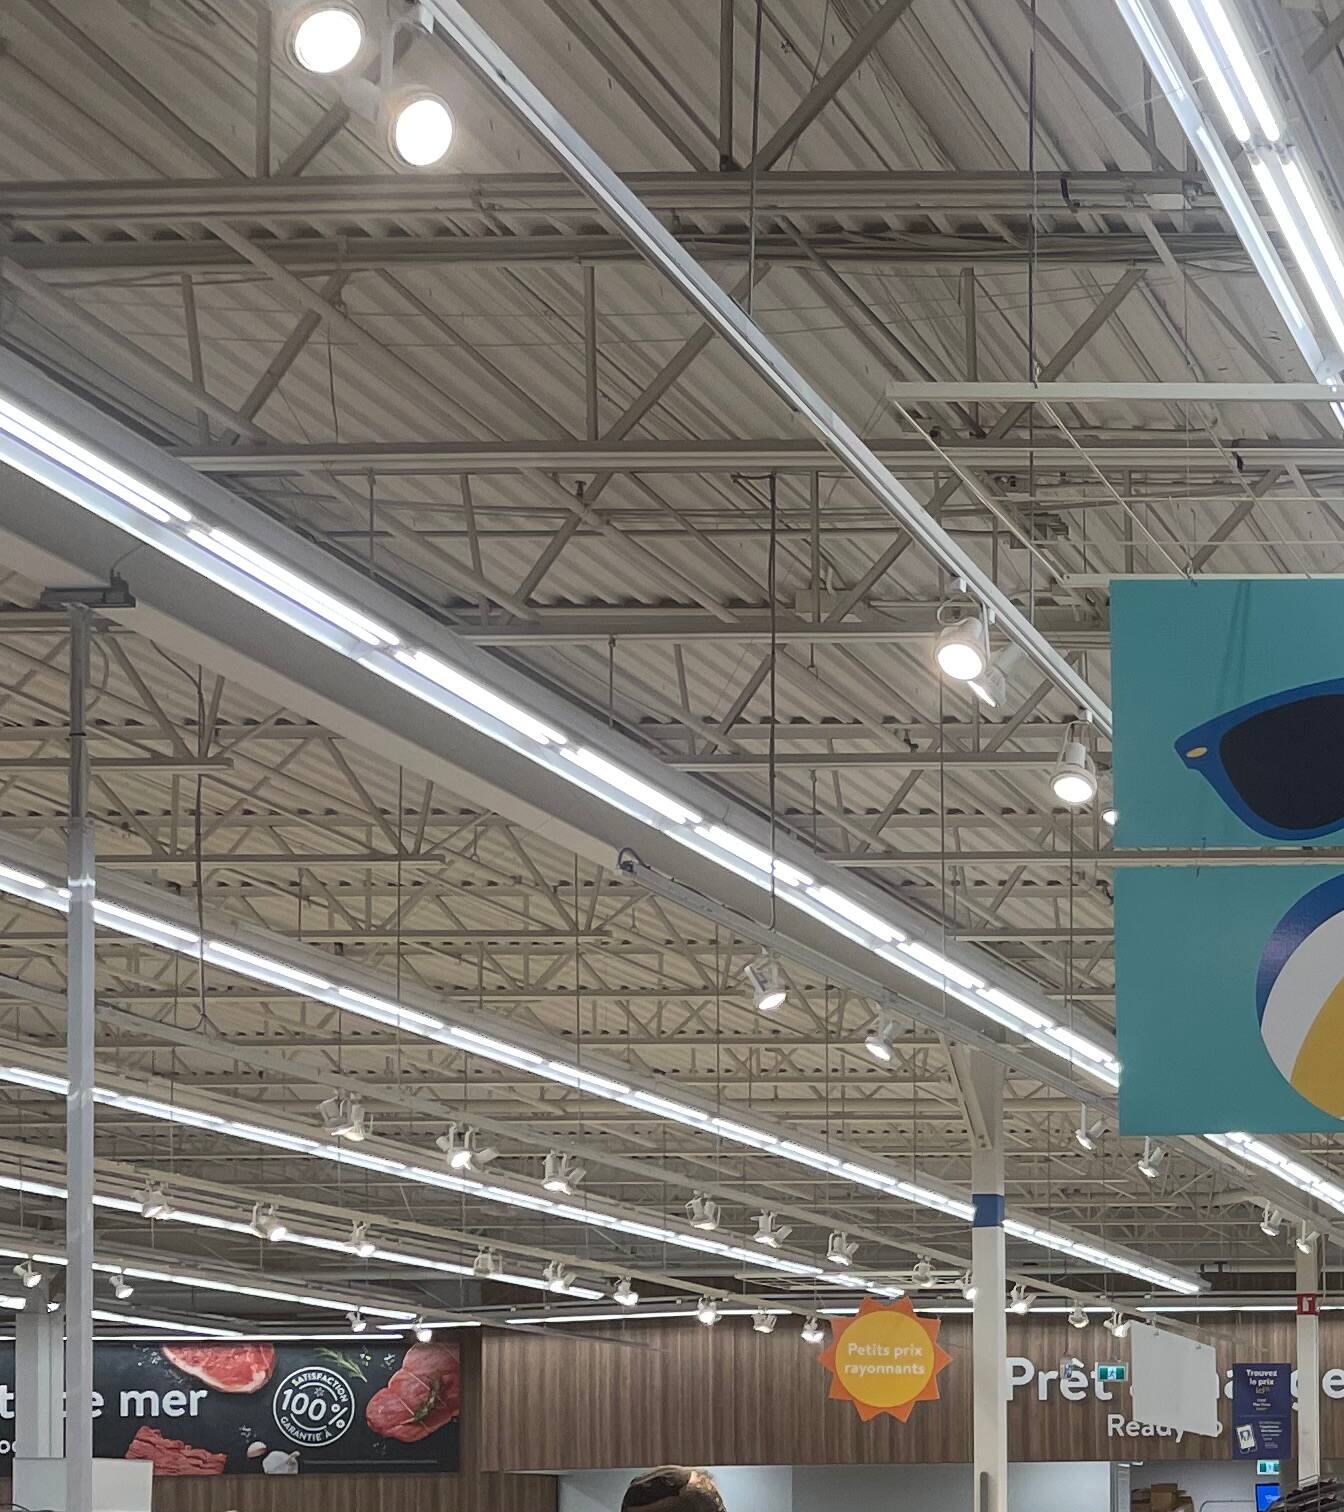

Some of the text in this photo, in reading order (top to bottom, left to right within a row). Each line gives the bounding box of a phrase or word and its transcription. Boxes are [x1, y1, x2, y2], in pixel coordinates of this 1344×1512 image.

[847, 1343, 922, 1360] Petits prix
[844, 1363, 925, 1377] rayonnants
[1006, 1357, 1112, 1401] Prêt
[291, 1372, 349, 1403] SATISFACTION
[119, 1389, 208, 1417] mer
[280, 1416, 322, 1441] GARANTIE
